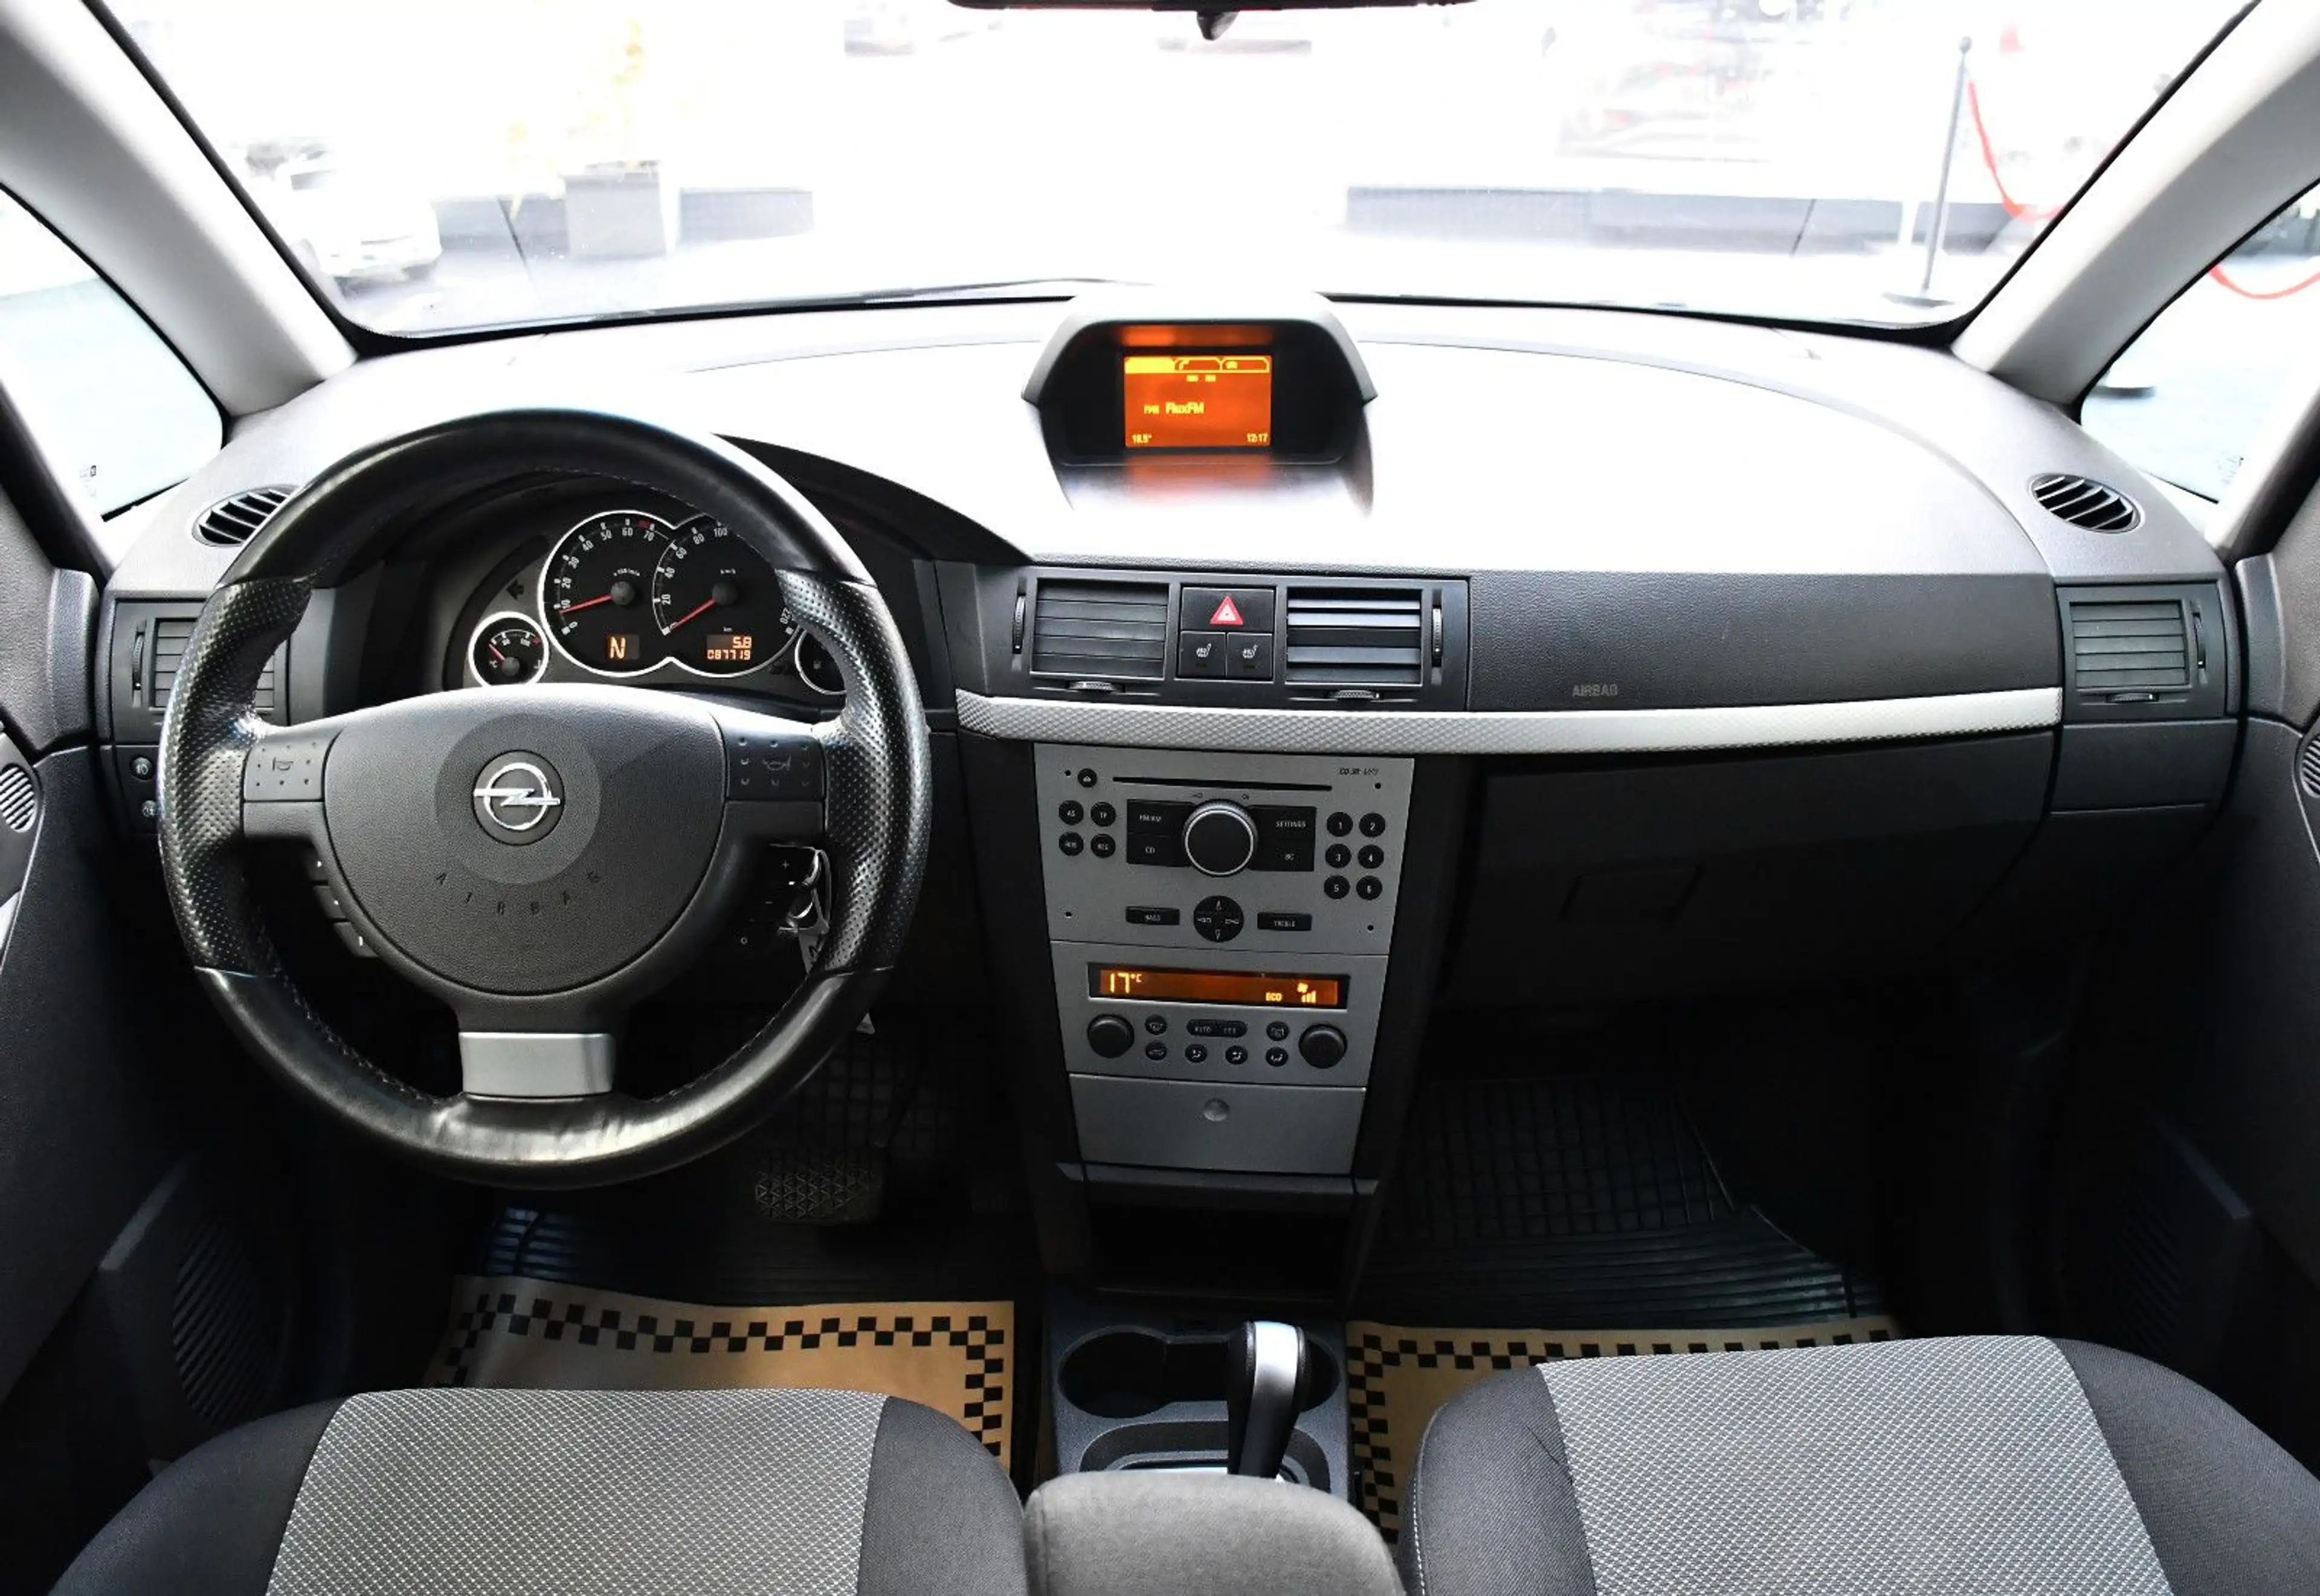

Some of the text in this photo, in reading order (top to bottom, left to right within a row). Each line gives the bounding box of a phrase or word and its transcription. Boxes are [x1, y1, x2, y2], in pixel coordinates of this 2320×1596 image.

[1246, 433, 1268, 443] 12:17
[601, 530, 612, 541] 50
[643, 530, 655, 541] 70
[714, 527, 727, 537] 100
[693, 533, 704, 544] 80
[582, 540, 594, 552] 40
[675, 547, 687, 559] 60
[561, 577, 572, 589] 20
[662, 594, 671, 605] 20
[610, 636, 626, 659] N
[1572, 683, 1618, 697] AIRBAG
[1338, 822, 1342, 830] 1
[1370, 822, 1376, 831] 2
[1335, 853, 1341, 862] 3
[1368, 854, 1374, 863] 4
[1333, 884, 1339, 892] 5
[1265, 991, 1283, 1003] ECO
